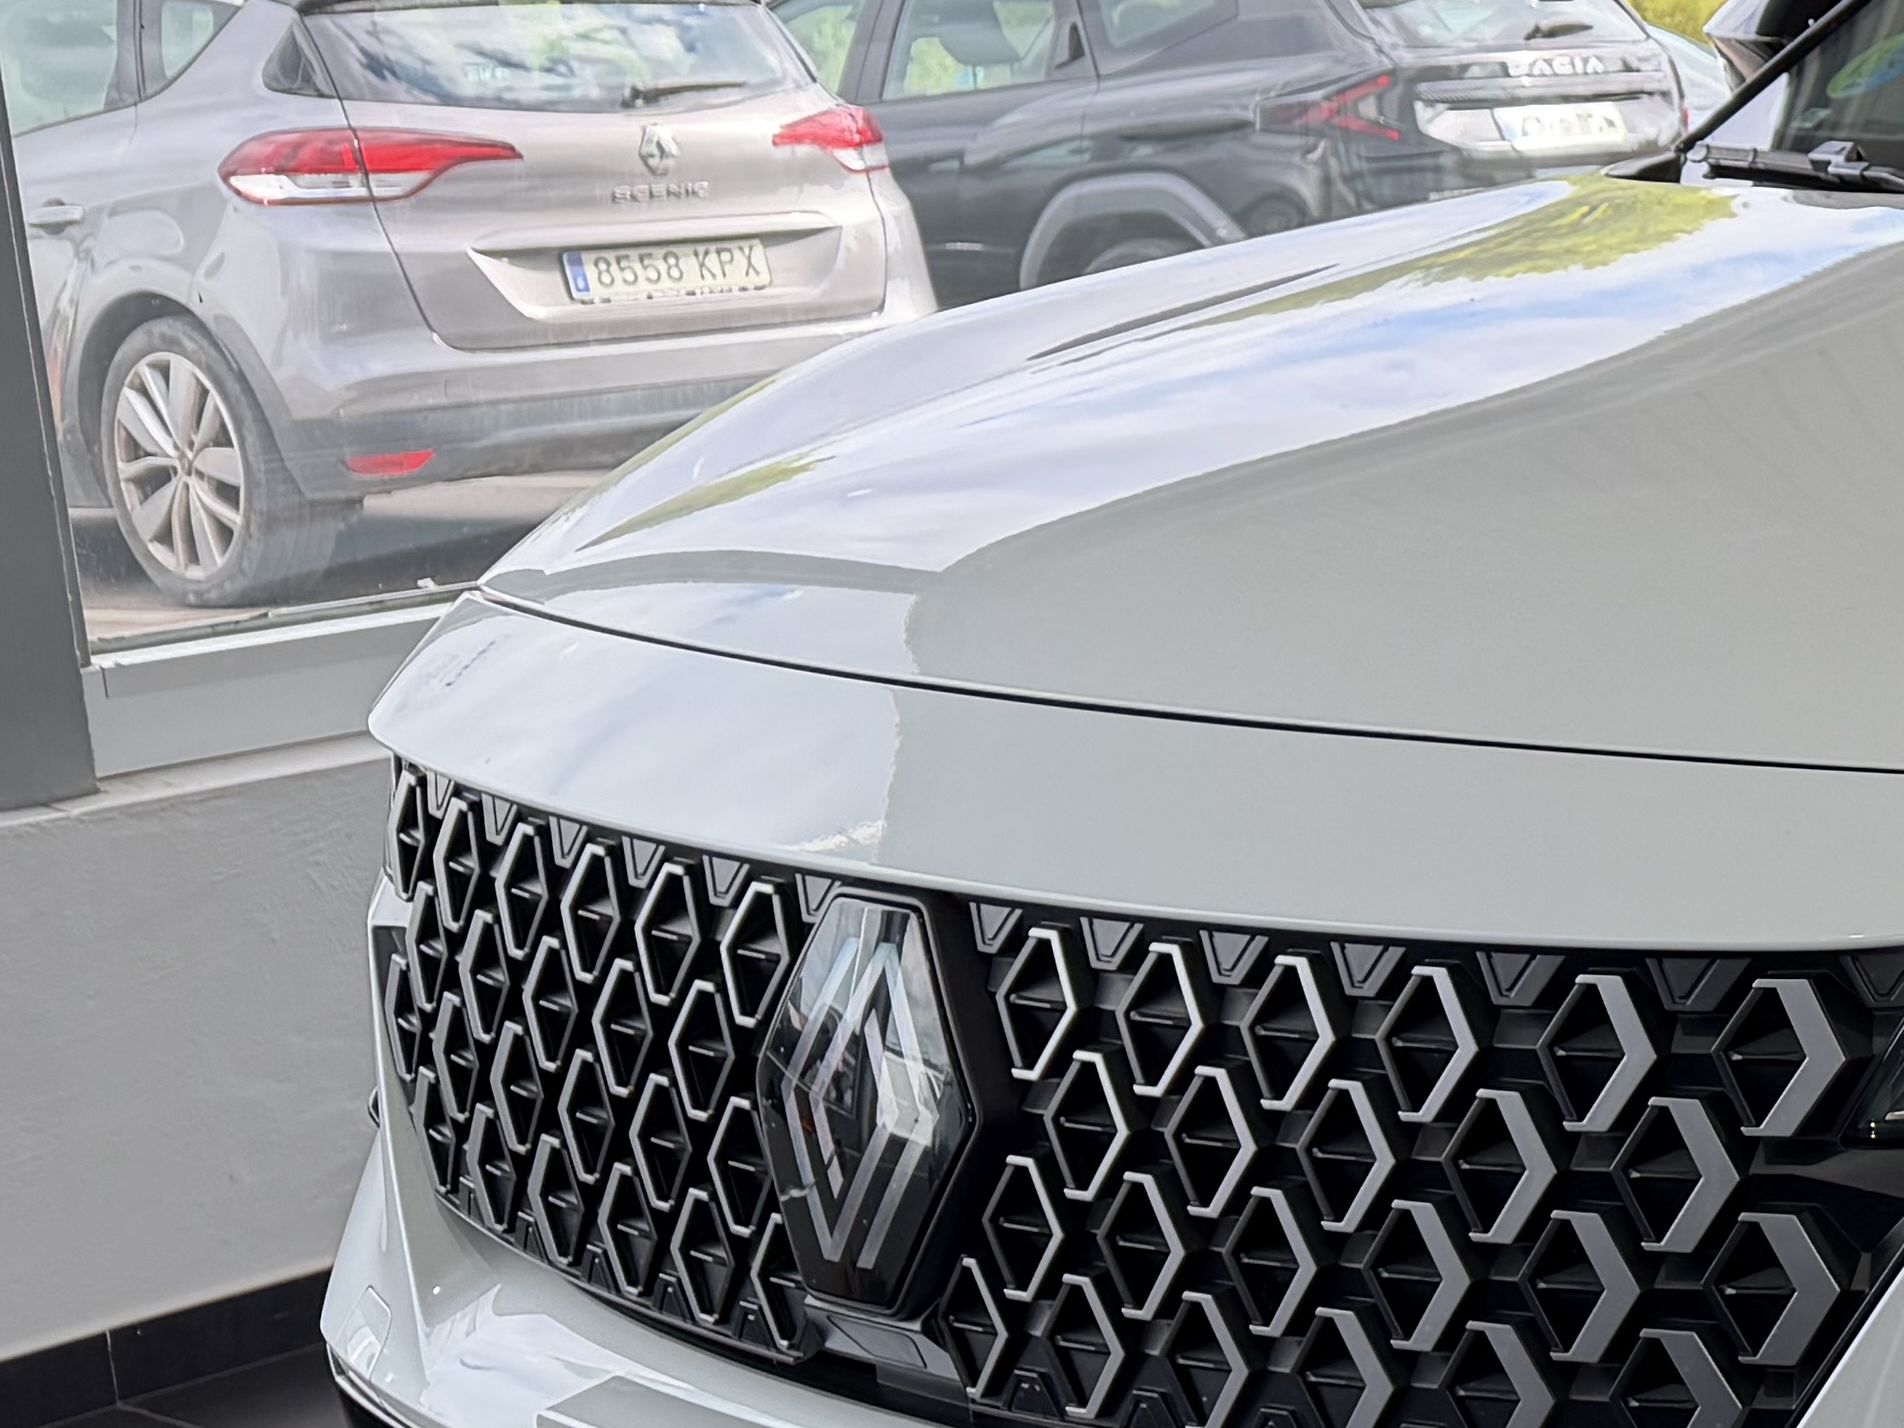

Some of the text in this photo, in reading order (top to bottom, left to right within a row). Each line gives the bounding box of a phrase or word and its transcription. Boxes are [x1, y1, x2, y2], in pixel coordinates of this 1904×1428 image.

[612, 181, 709, 204] SCENIC
[593, 243, 761, 288] 8558 KPX
